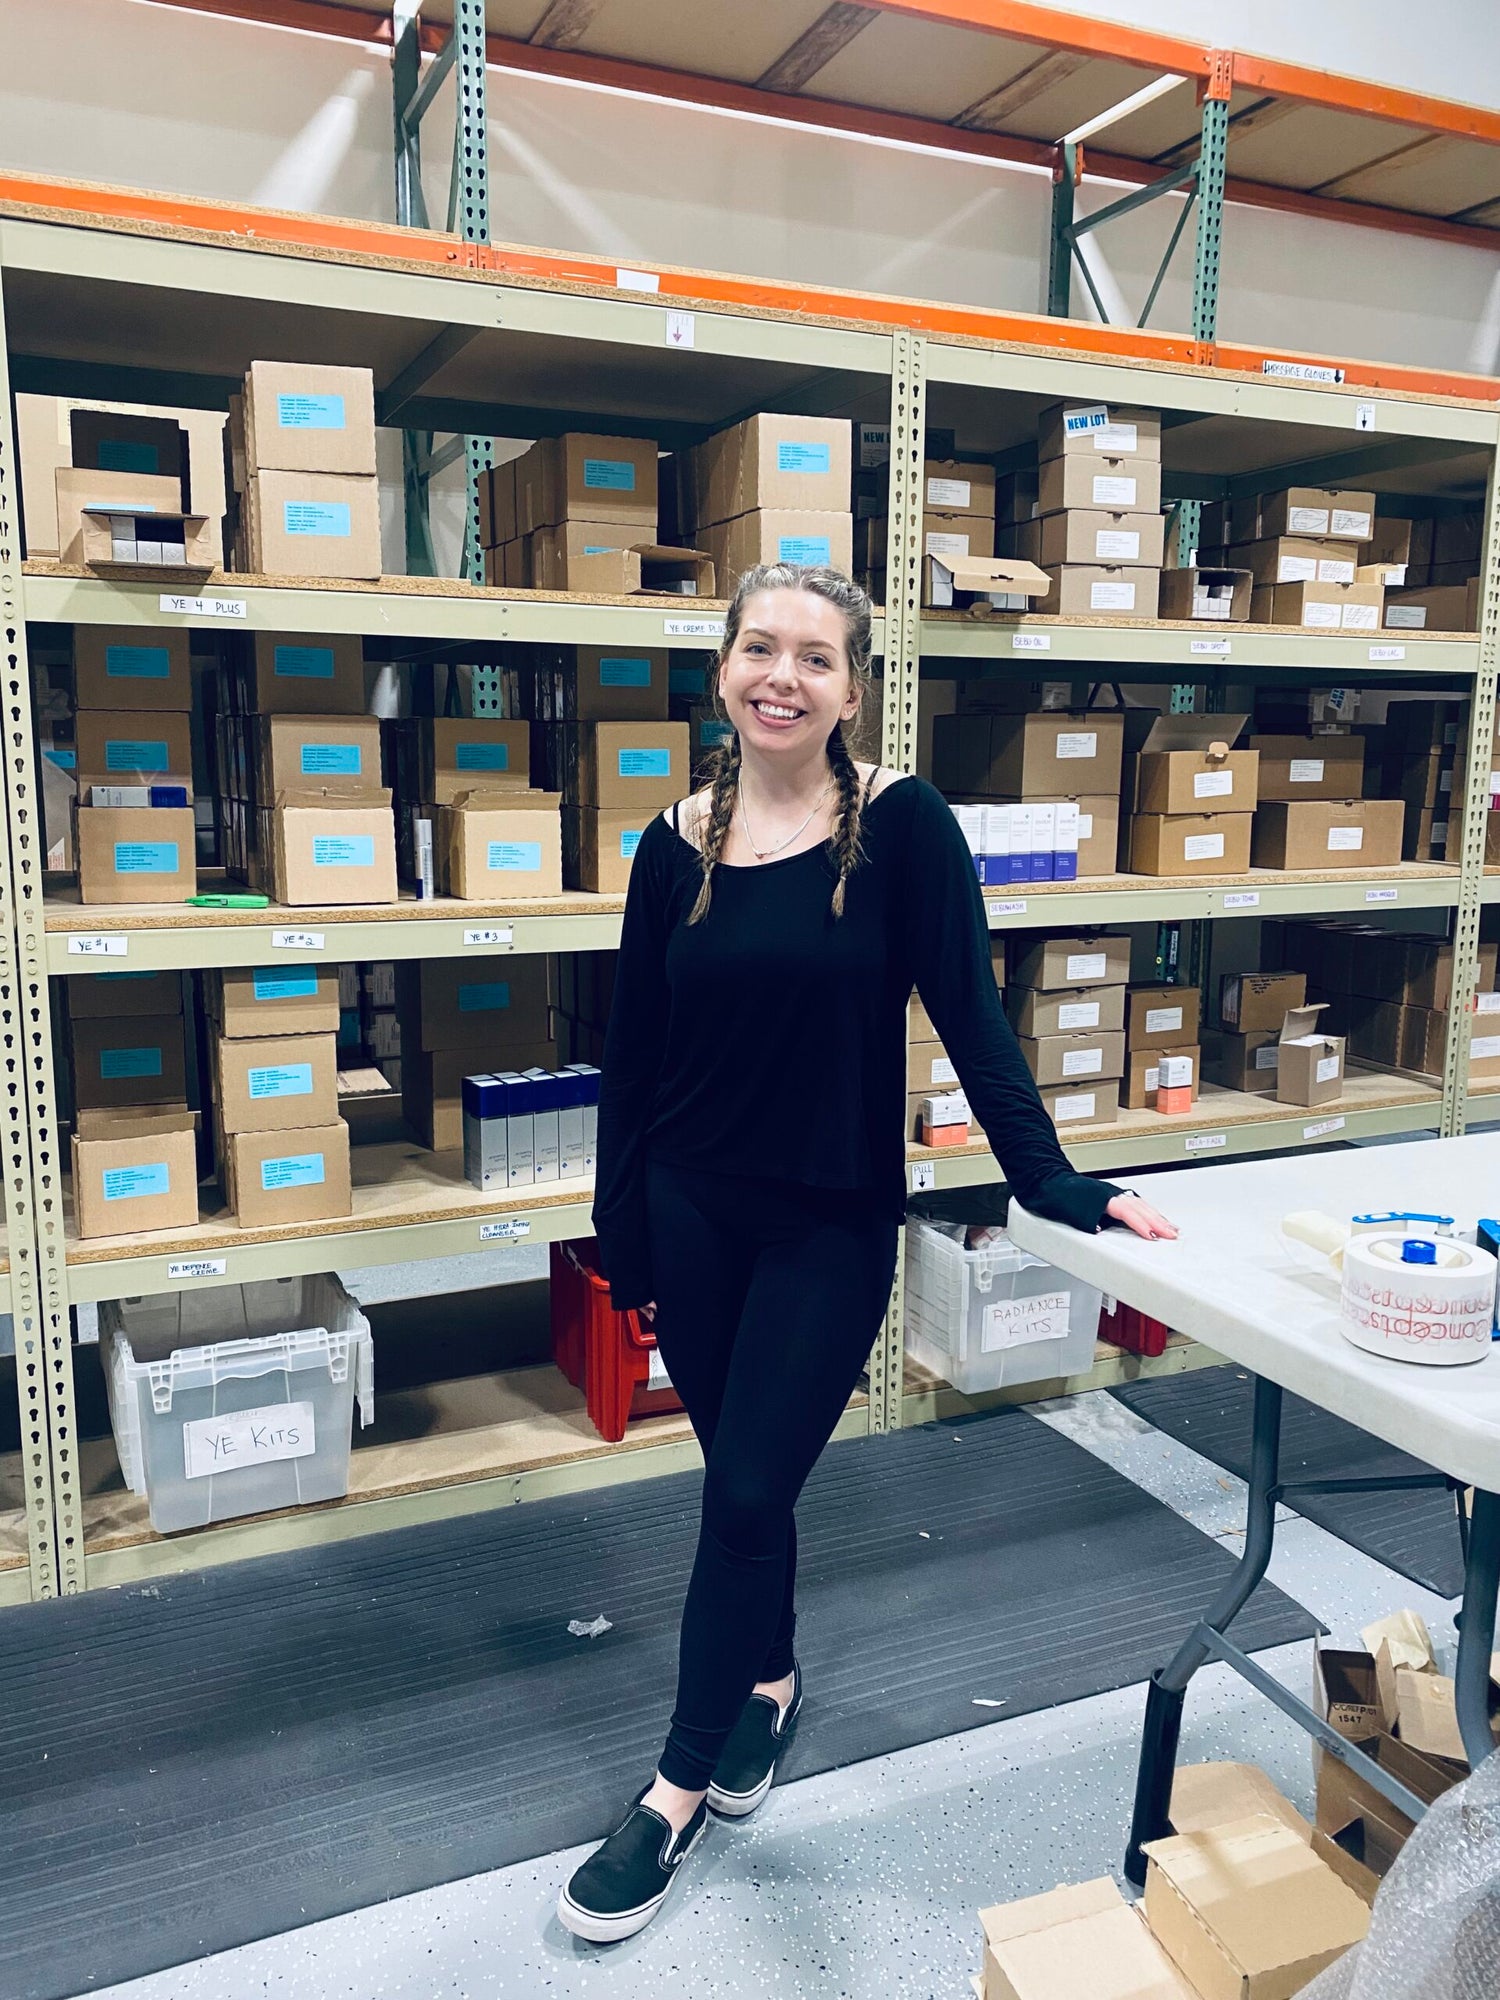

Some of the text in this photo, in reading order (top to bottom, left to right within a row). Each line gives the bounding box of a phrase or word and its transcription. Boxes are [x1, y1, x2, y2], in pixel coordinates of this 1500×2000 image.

[1304, 367, 1333, 381] GLOVES
[1067, 413, 1106, 430] NEW LOT
[863, 431, 885, 443] NEW
[171, 598, 241, 615] YE 4 PLUS
[669, 624, 680, 633] YE
[283, 935, 296, 944] YE
[470, 933, 481, 942] YE
[78, 940, 92, 951] YE
[913, 1164, 933, 1175] PULL
[991, 1297, 1071, 1321] RADIANCE
[1008, 1317, 1052, 1336] KITS
[205, 1426, 300, 1460] YE KITS
[1339, 1715, 1362, 1724] 1547
